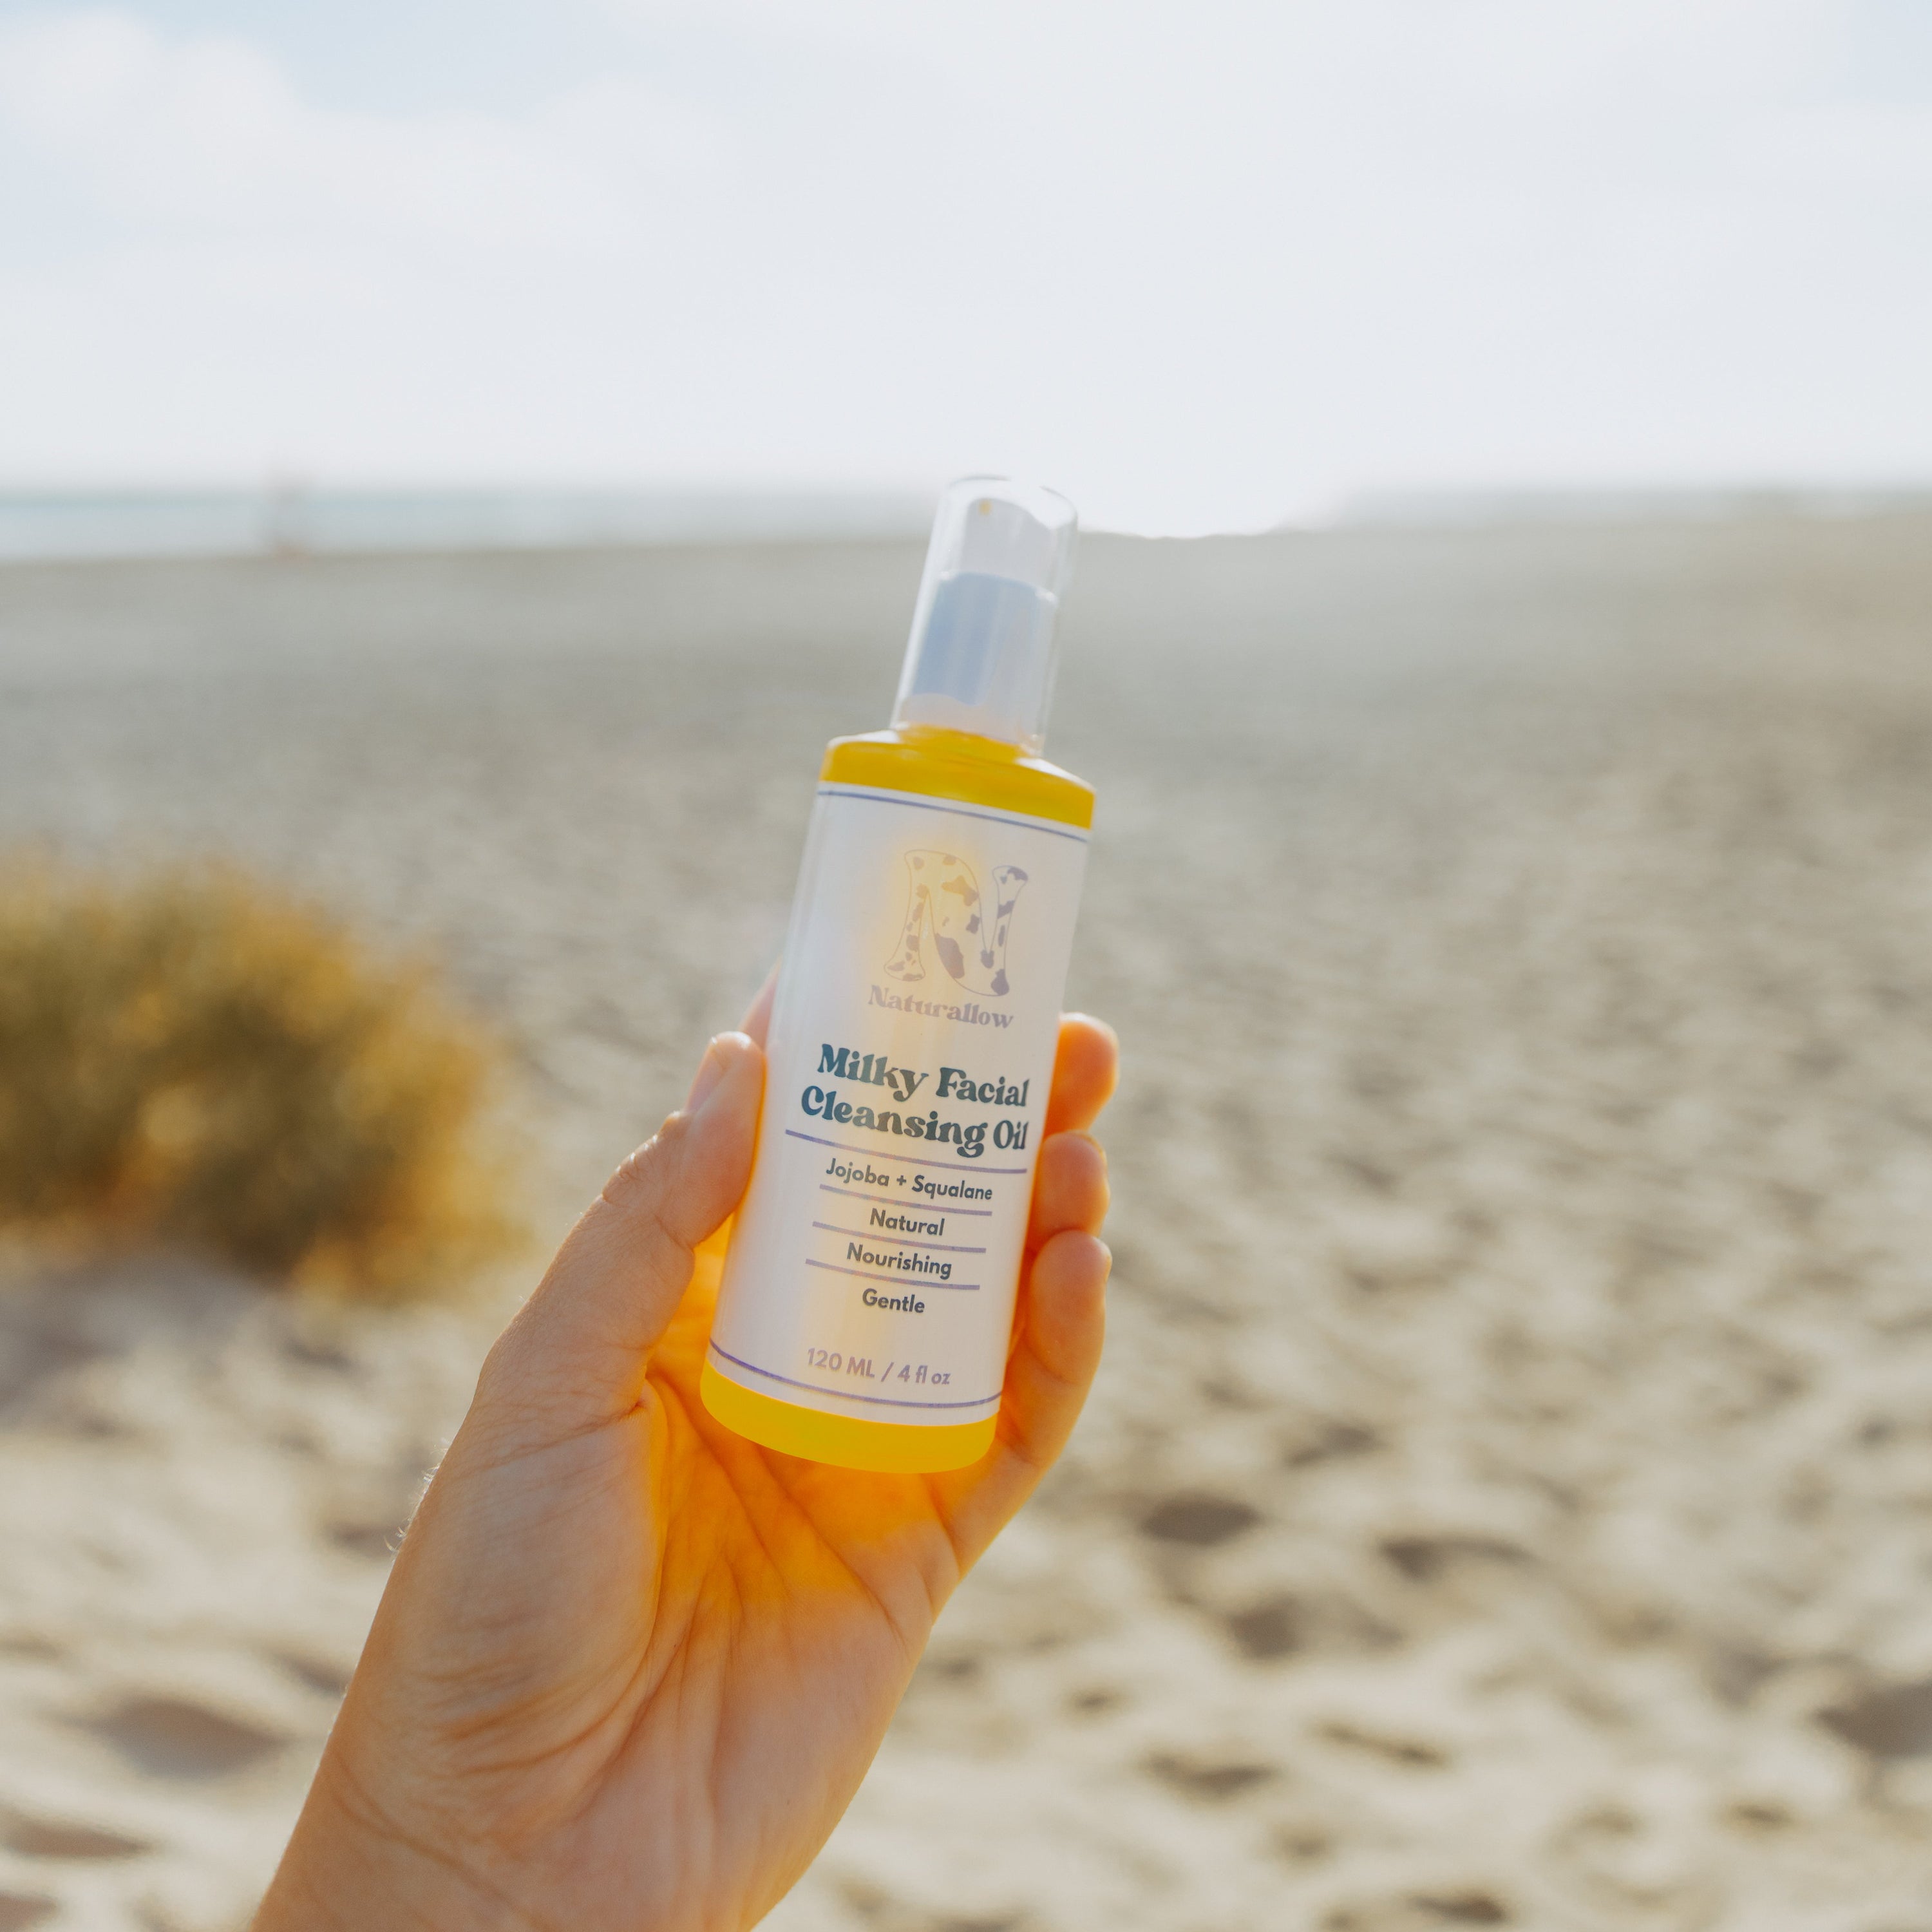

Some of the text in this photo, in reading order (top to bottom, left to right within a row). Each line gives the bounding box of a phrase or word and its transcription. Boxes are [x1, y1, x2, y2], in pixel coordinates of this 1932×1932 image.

[868, 985, 1014, 1028] Naturallow
[817, 1043, 1029, 1107] Milky Facial
[801, 1085, 1029, 1158] Cleansing Oil
[826, 1158, 993, 1200] Jojoba + Squalane
[870, 1208, 945, 1236] Natural
[846, 1242, 952, 1280] Nourishing
[862, 1288, 925, 1313] Gentle
[808, 1348, 951, 1385] 120 ML / 4 fl oz
